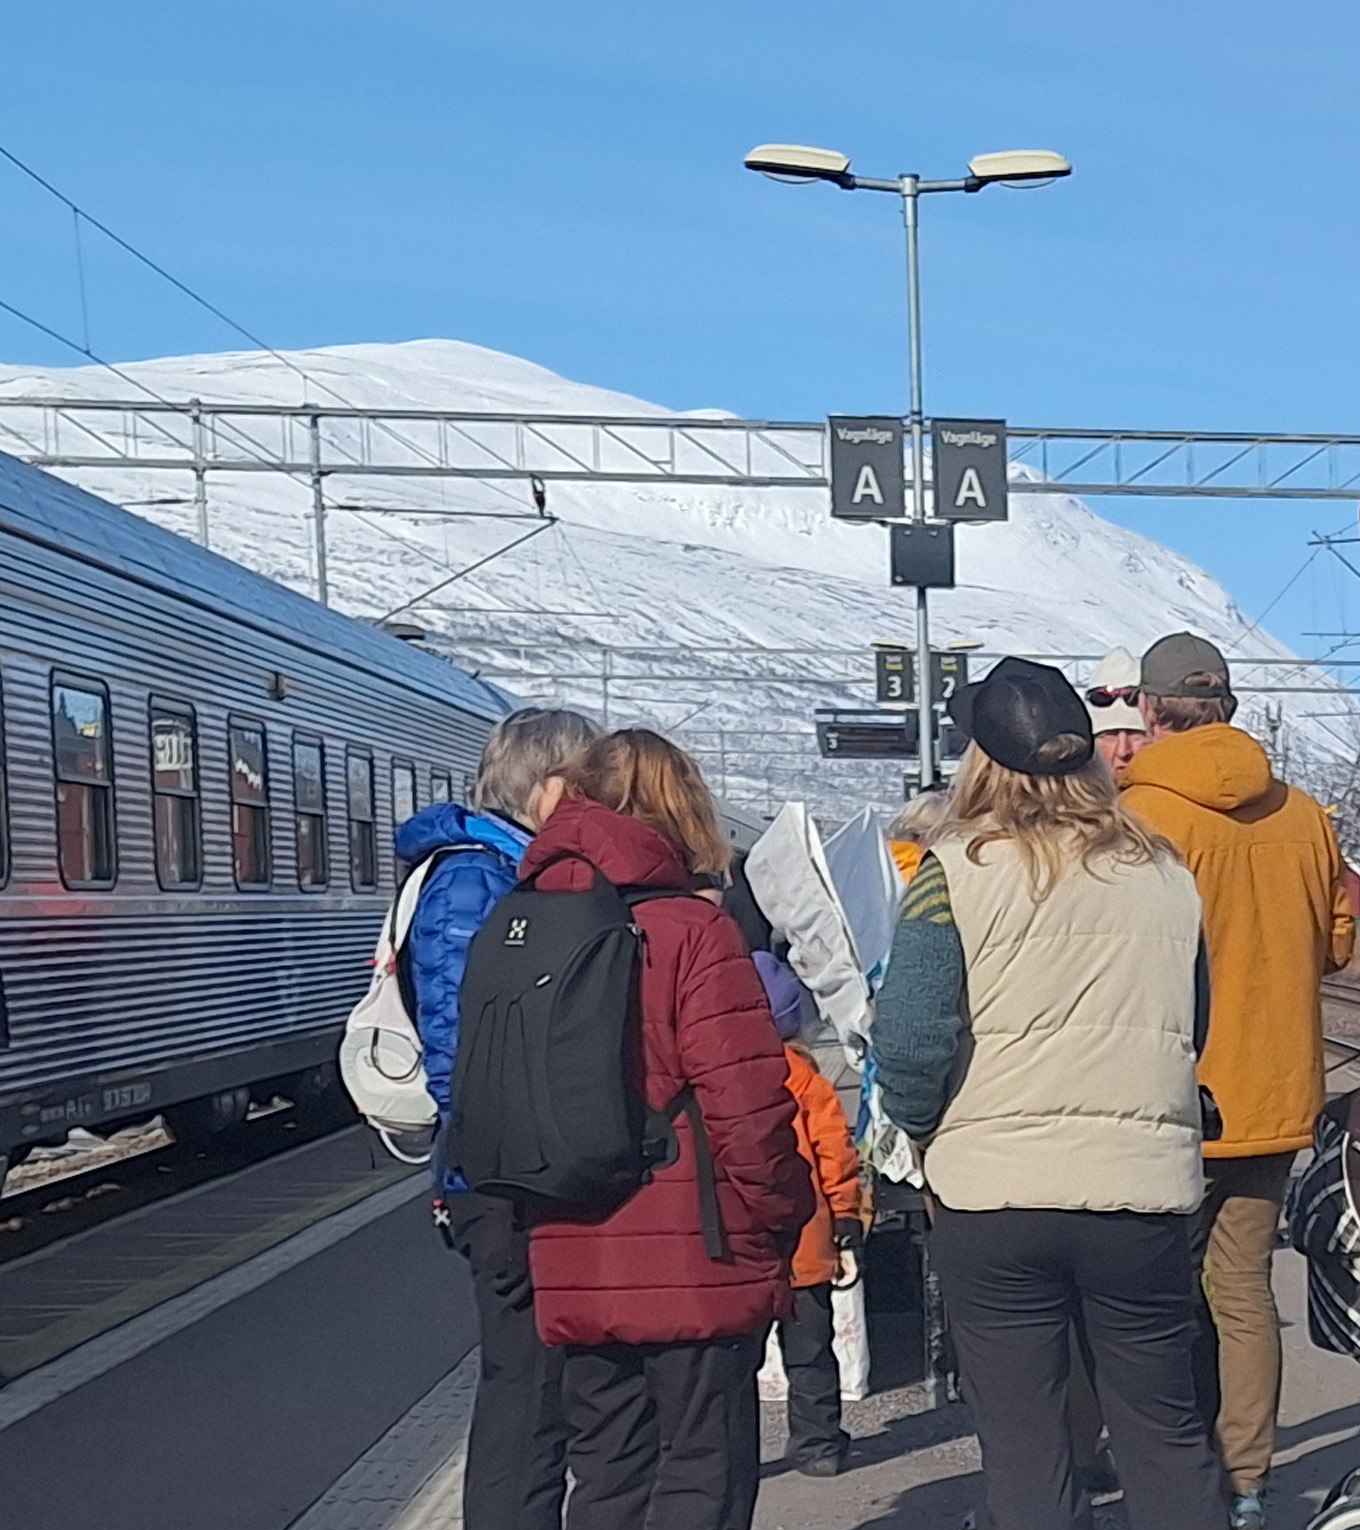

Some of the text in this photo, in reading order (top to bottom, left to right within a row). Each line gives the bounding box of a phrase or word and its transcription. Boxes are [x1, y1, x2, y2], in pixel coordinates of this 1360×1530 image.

[852, 465, 884, 504] A
[955, 468, 987, 507] A
[887, 675, 902, 697] 3
